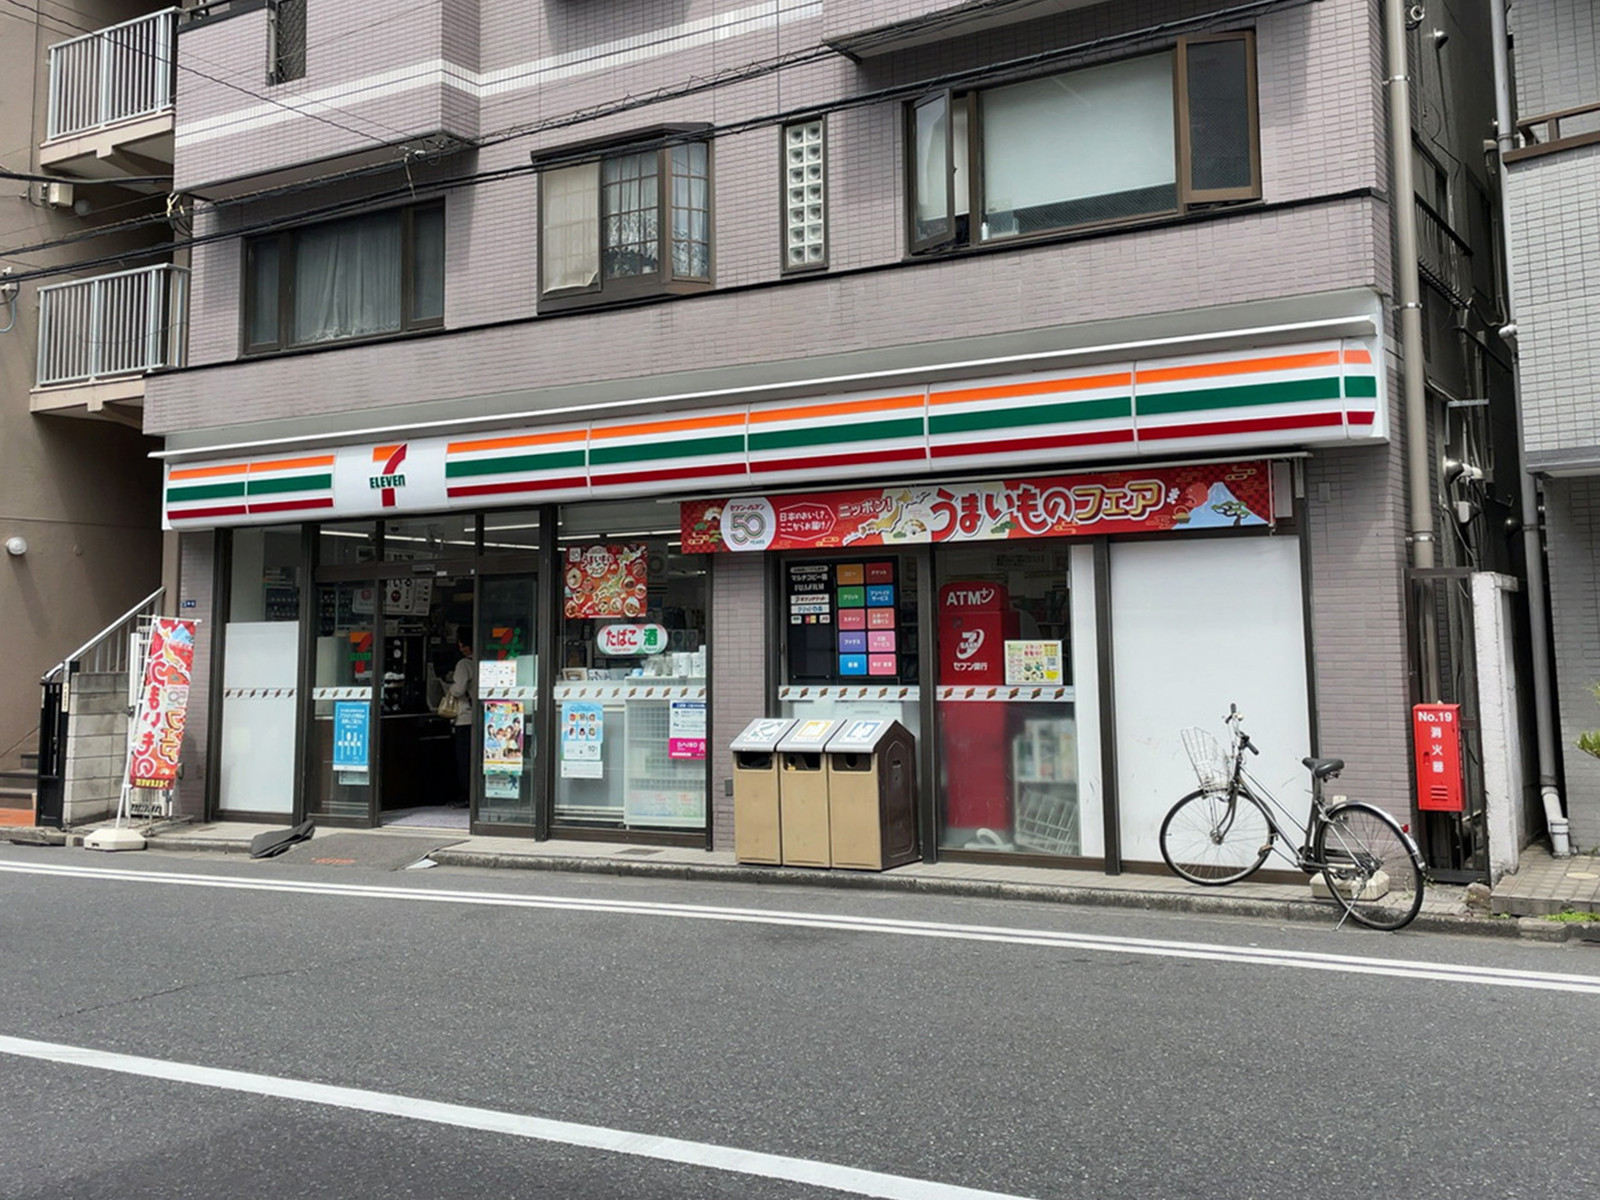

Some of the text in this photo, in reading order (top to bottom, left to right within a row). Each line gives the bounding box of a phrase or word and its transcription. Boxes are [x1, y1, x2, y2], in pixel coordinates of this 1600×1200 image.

[839, 497, 893, 518] ニッポン!
[730, 511, 767, 546] 50
[794, 583, 825, 592] FUJIFILM
[605, 628, 638, 647] たばこ
[643, 628, 658, 646] 酒
[953, 661, 988, 671] セブン銀行
[1418, 711, 1452, 723] No.19
[1430, 725, 1445, 773] 消火器
